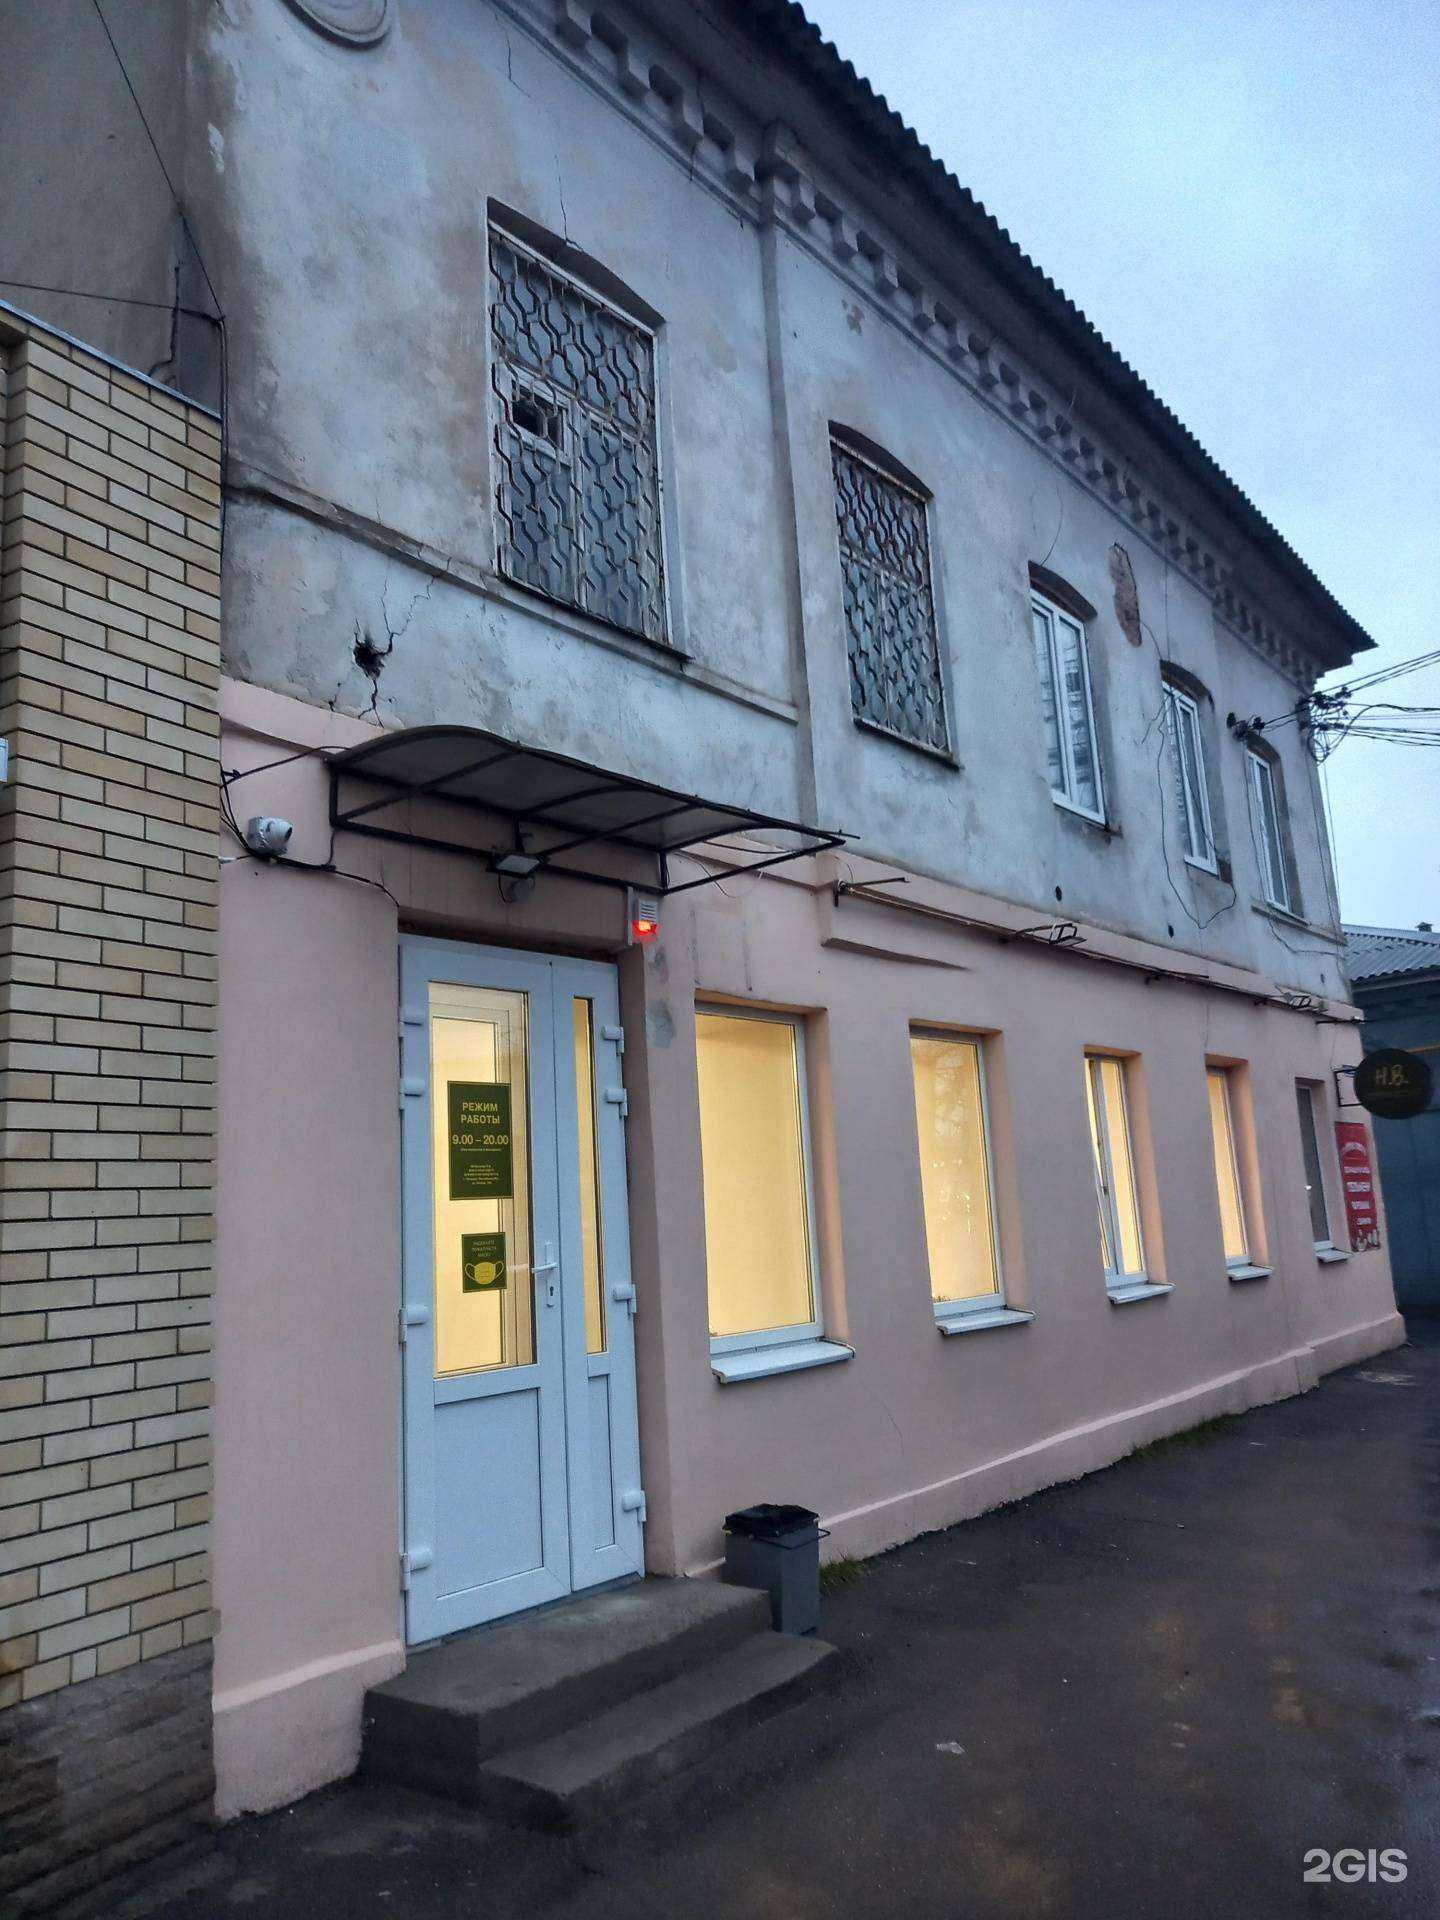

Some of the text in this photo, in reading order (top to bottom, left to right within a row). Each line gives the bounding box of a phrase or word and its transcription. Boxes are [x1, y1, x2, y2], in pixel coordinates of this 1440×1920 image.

[462, 1102, 498, 1112] РЕЖИМ
[460, 1114, 501, 1125] РАБОТЫ
[452, 1134, 474, 1145] 9.00
[483, 1134, 509, 1145] 20.00
